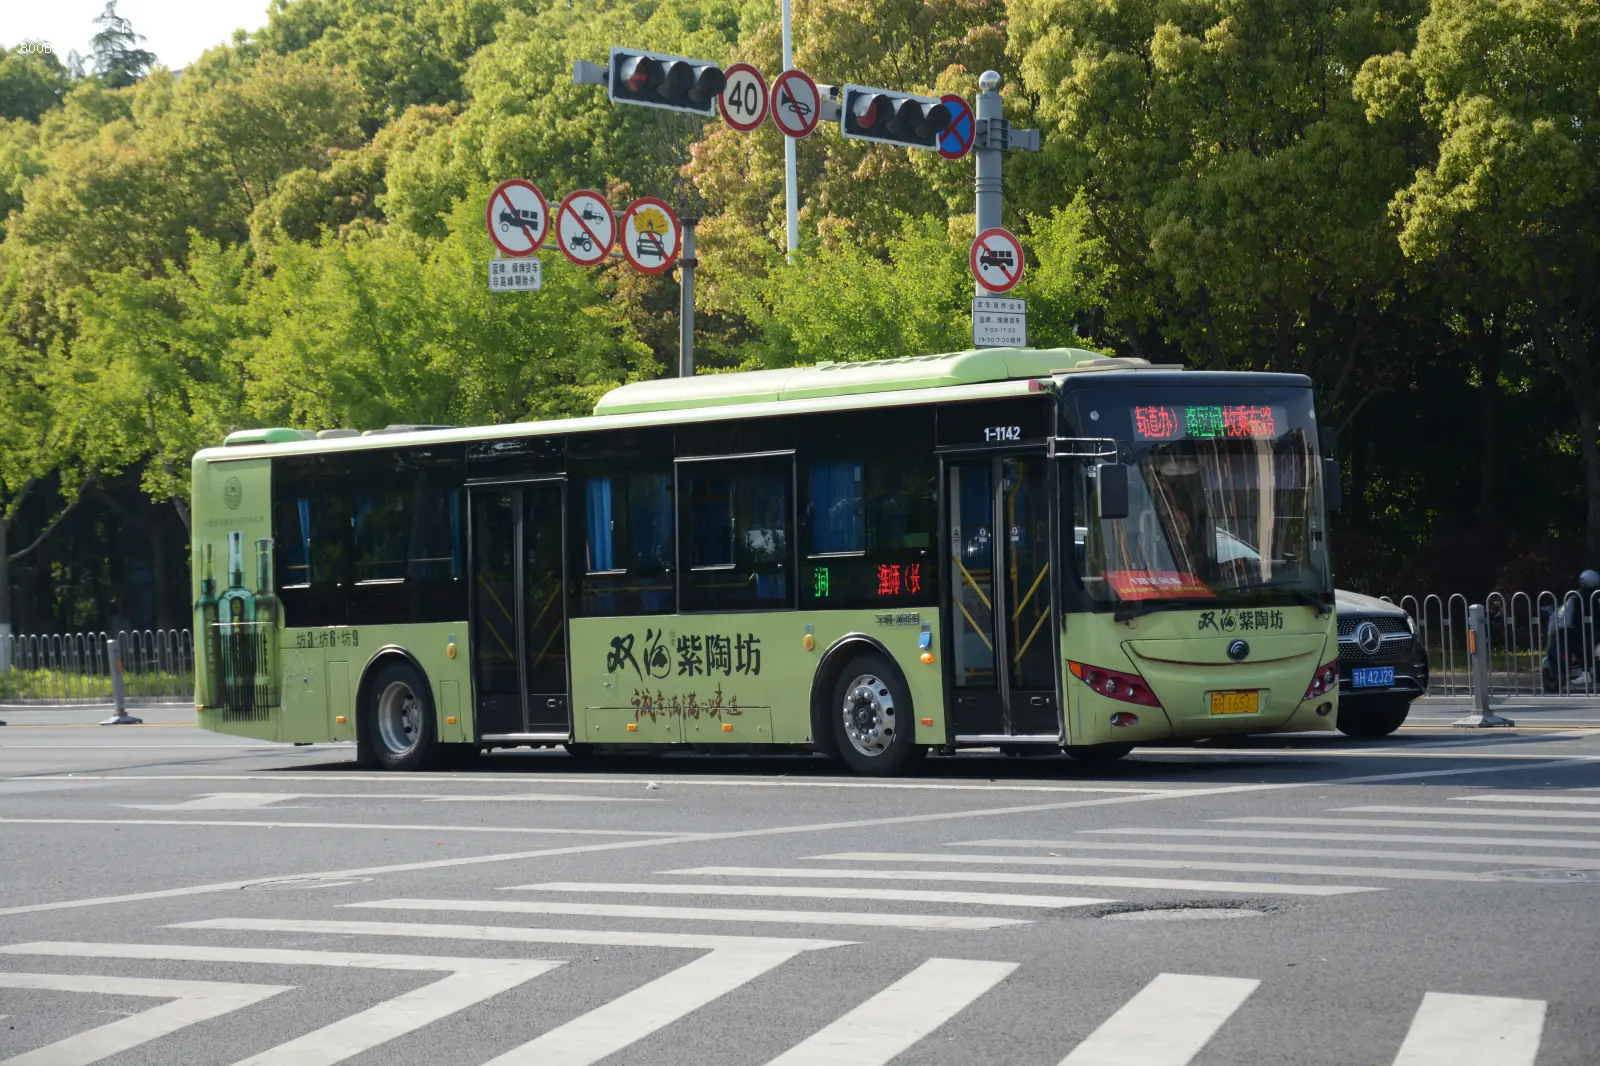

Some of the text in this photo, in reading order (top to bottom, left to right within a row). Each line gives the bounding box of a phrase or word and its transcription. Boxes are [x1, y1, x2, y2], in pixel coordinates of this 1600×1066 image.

[728, 80, 758, 116] 40
[492, 275, 536, 288] 非高峰期除外
[984, 426, 1021, 442] 1-1142
